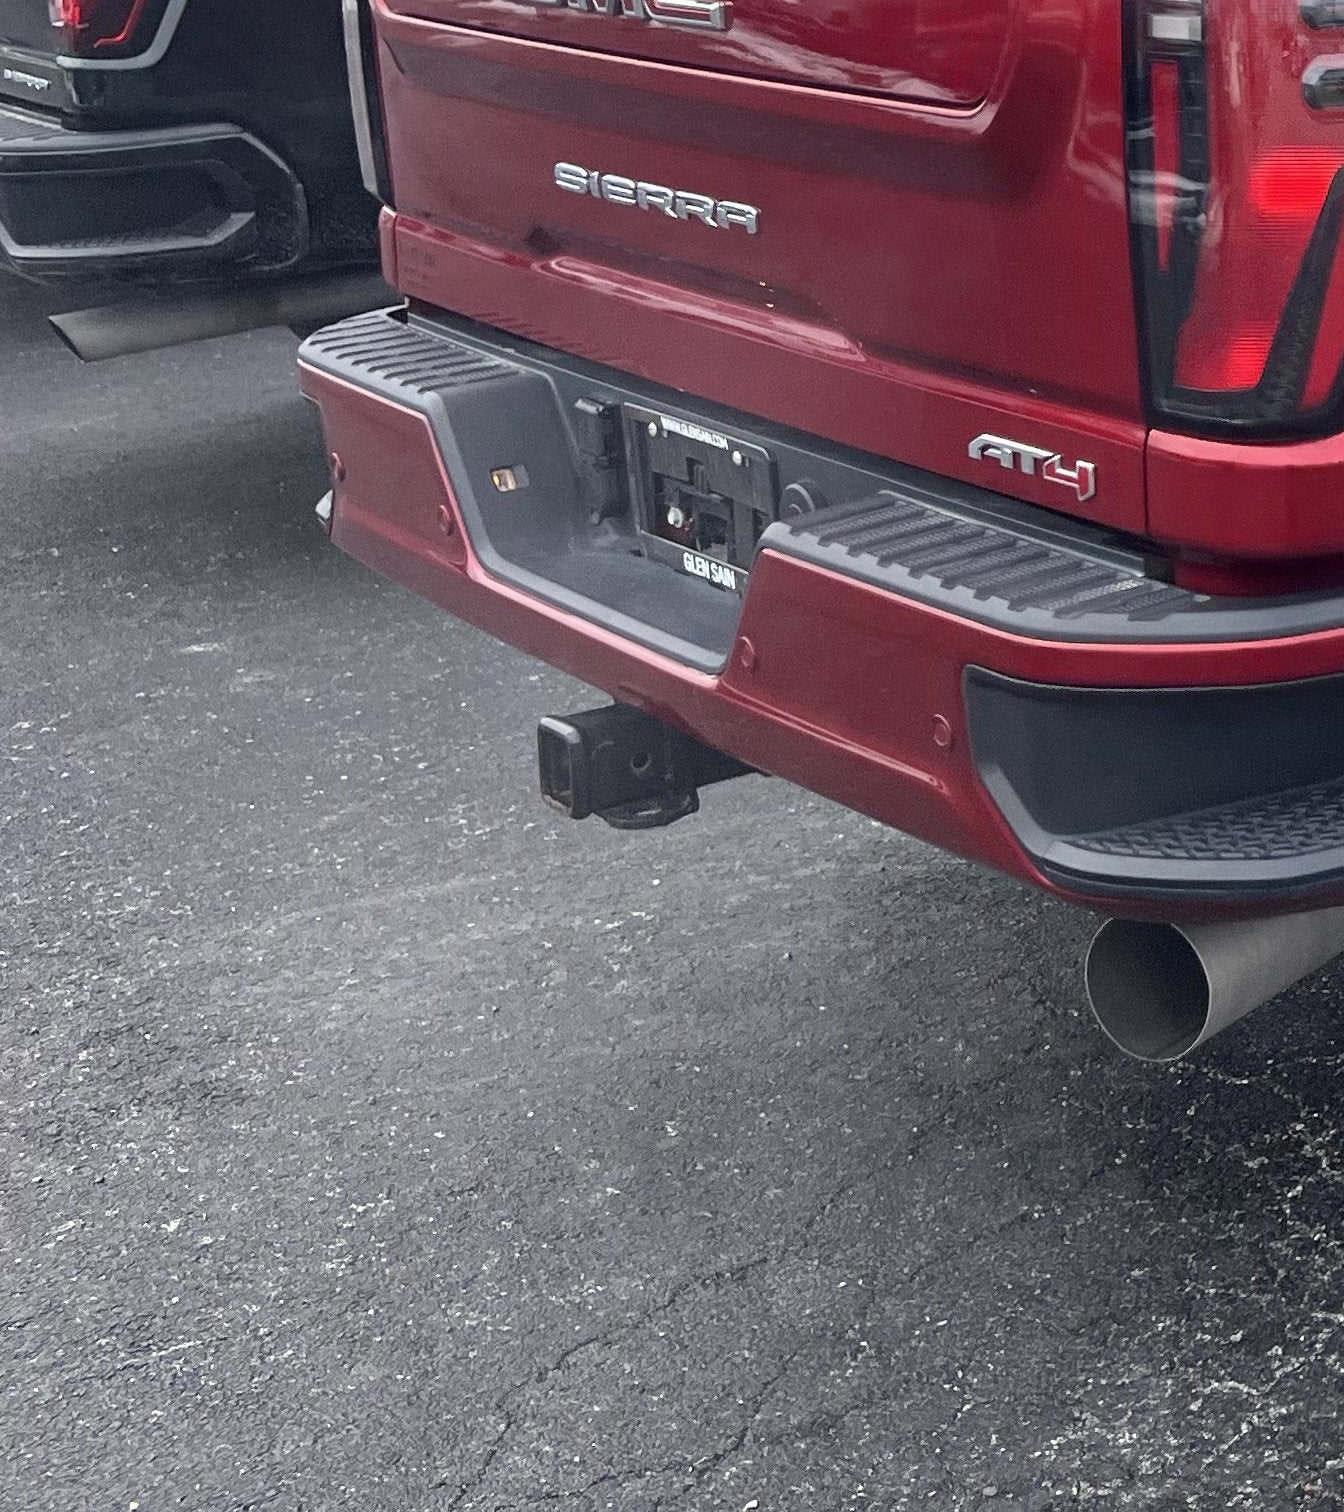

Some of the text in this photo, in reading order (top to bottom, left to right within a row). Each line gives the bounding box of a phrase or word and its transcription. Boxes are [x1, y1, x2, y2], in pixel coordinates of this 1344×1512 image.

[554, 162, 761, 235] SIERRA
[968, 433, 1095, 501] AT4
[683, 552, 736, 590] GLEN SAIN
